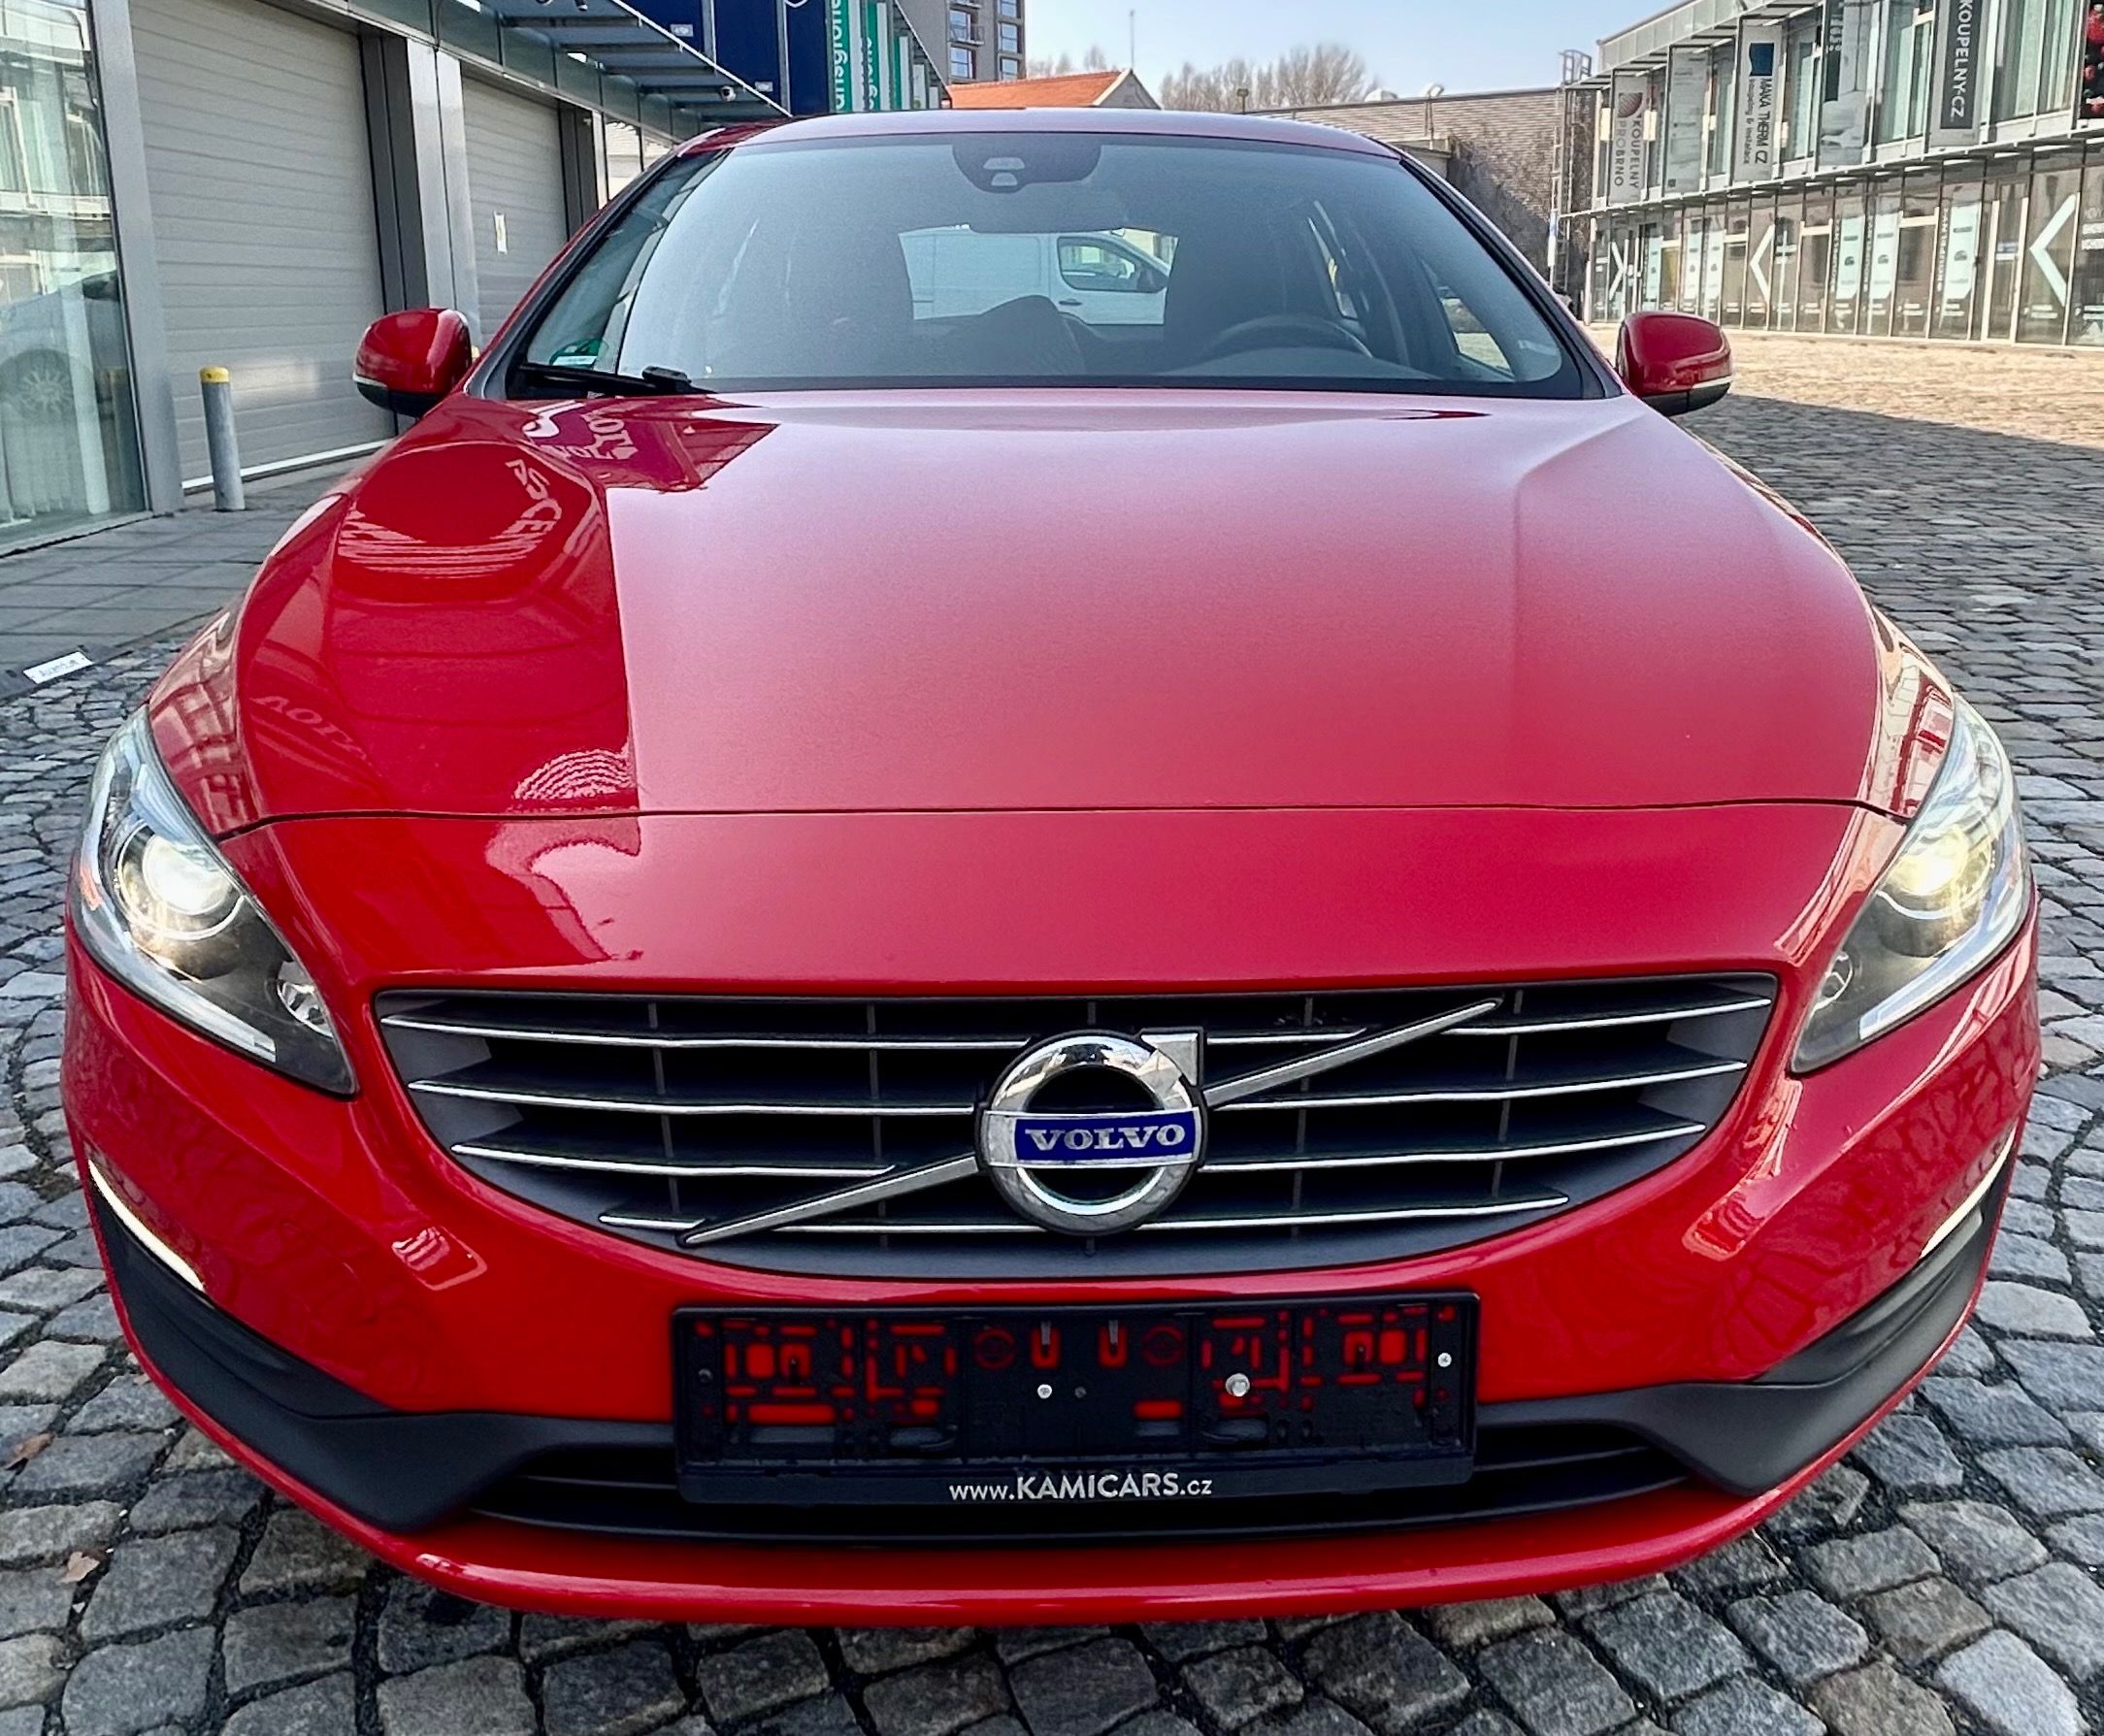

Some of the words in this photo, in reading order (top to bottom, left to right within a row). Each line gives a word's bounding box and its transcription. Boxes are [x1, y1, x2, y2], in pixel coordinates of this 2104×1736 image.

[1614, 120, 1627, 187] PROBRNO
[1628, 120, 1642, 189] KOUPELNY
[1755, 150, 1768, 164] CZ
[1025, 1124, 1186, 1151] VOLVO
[948, 1473, 1213, 1500] www.KAMICARS.cz
